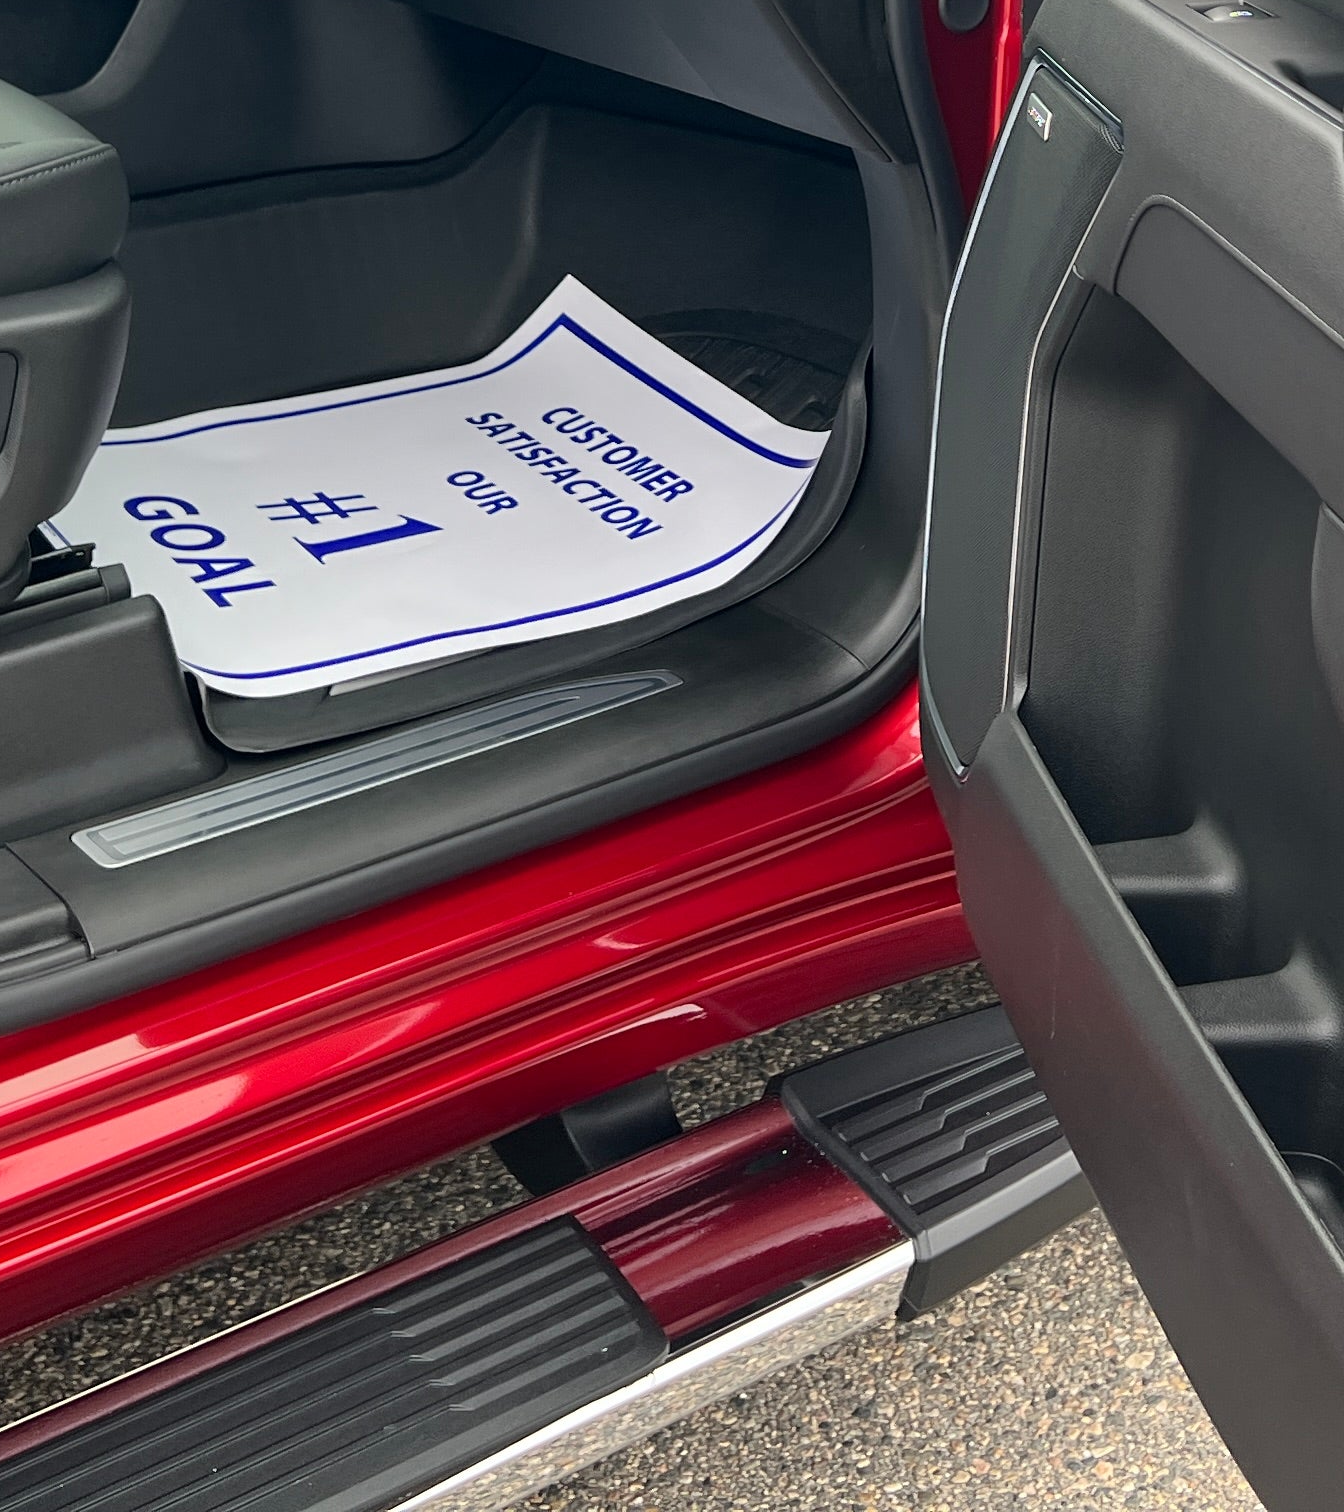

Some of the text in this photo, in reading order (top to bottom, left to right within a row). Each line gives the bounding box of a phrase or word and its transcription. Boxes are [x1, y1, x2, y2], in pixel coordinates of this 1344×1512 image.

[447, 470, 520, 516] OUR
[465, 411, 663, 541] SATISFACTION
[542, 407, 695, 503] CUSTOMER
[123, 495, 277, 608] GOAL
[258, 491, 444, 565] #1
